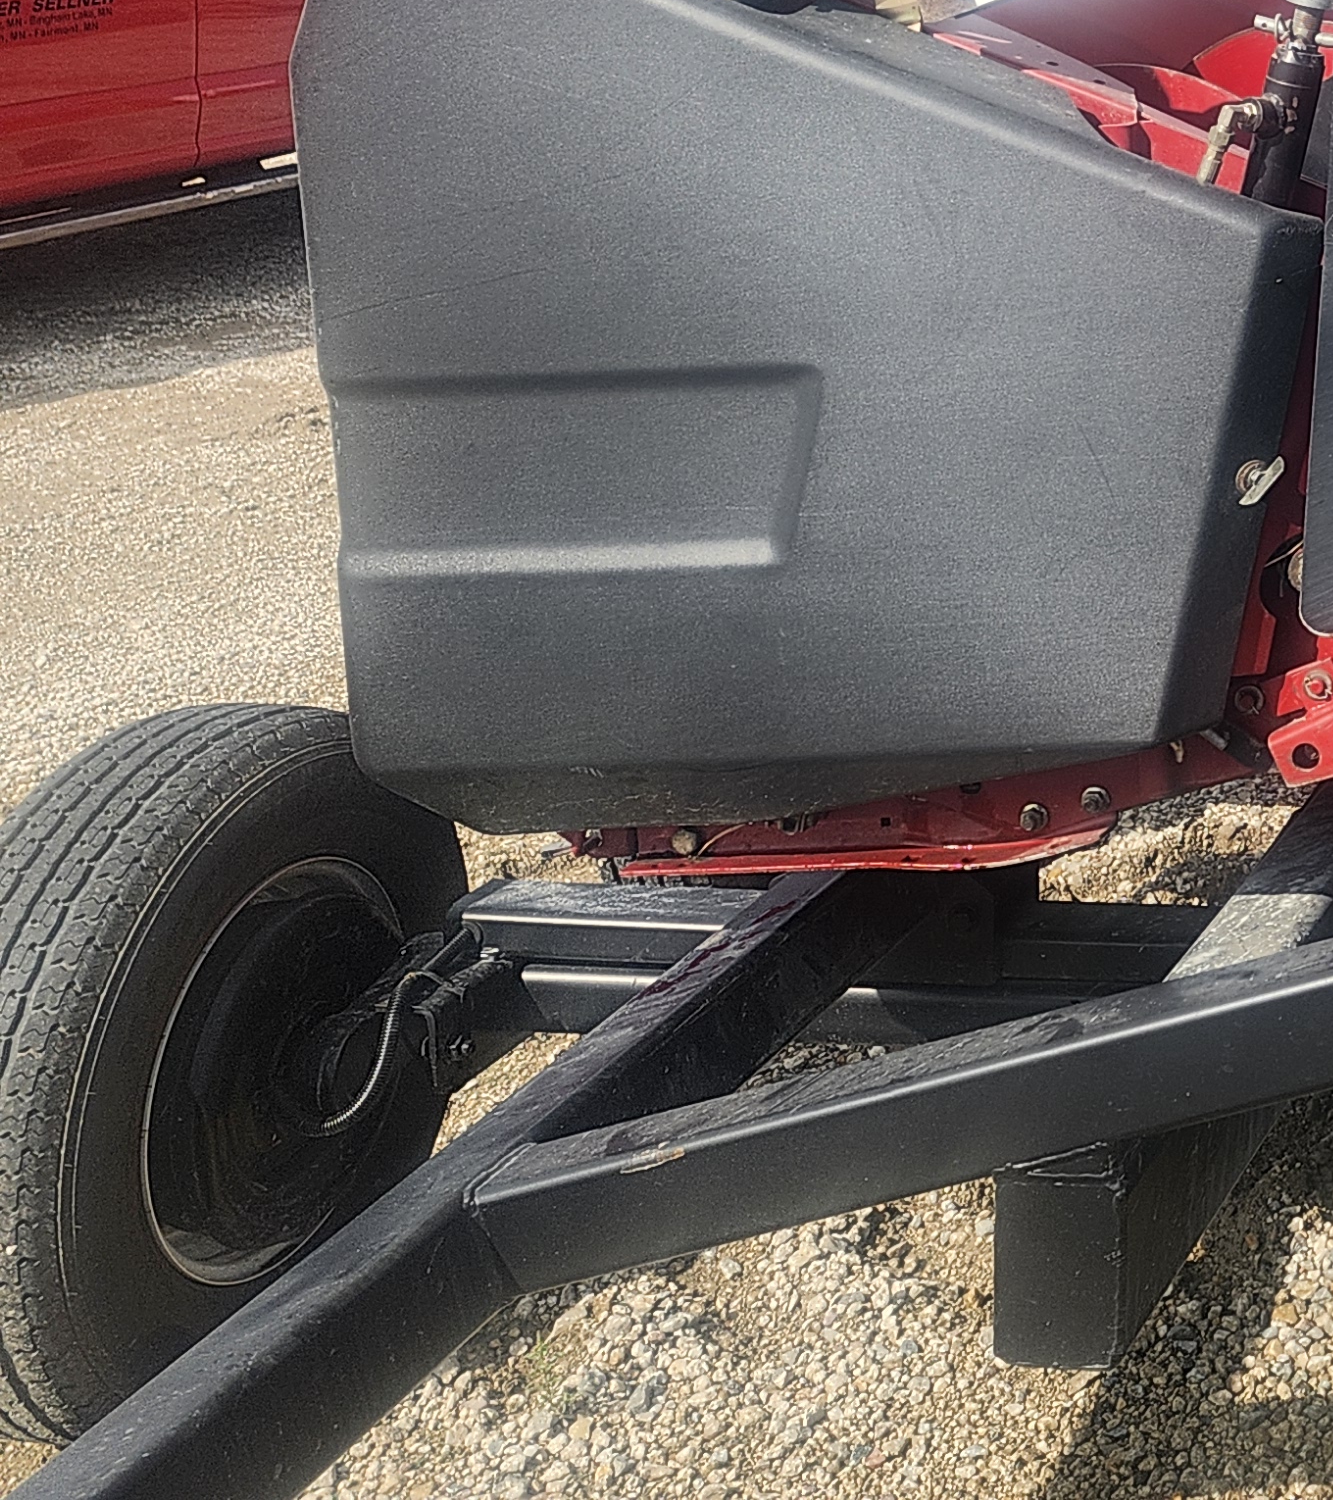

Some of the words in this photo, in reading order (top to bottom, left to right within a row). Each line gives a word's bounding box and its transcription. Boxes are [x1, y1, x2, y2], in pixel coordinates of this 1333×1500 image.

[7, 17, 22, 27] MN
[97, 7, 113, 17] MN
[10, 30, 26, 41] MN
[83, 20, 99, 31] MN
